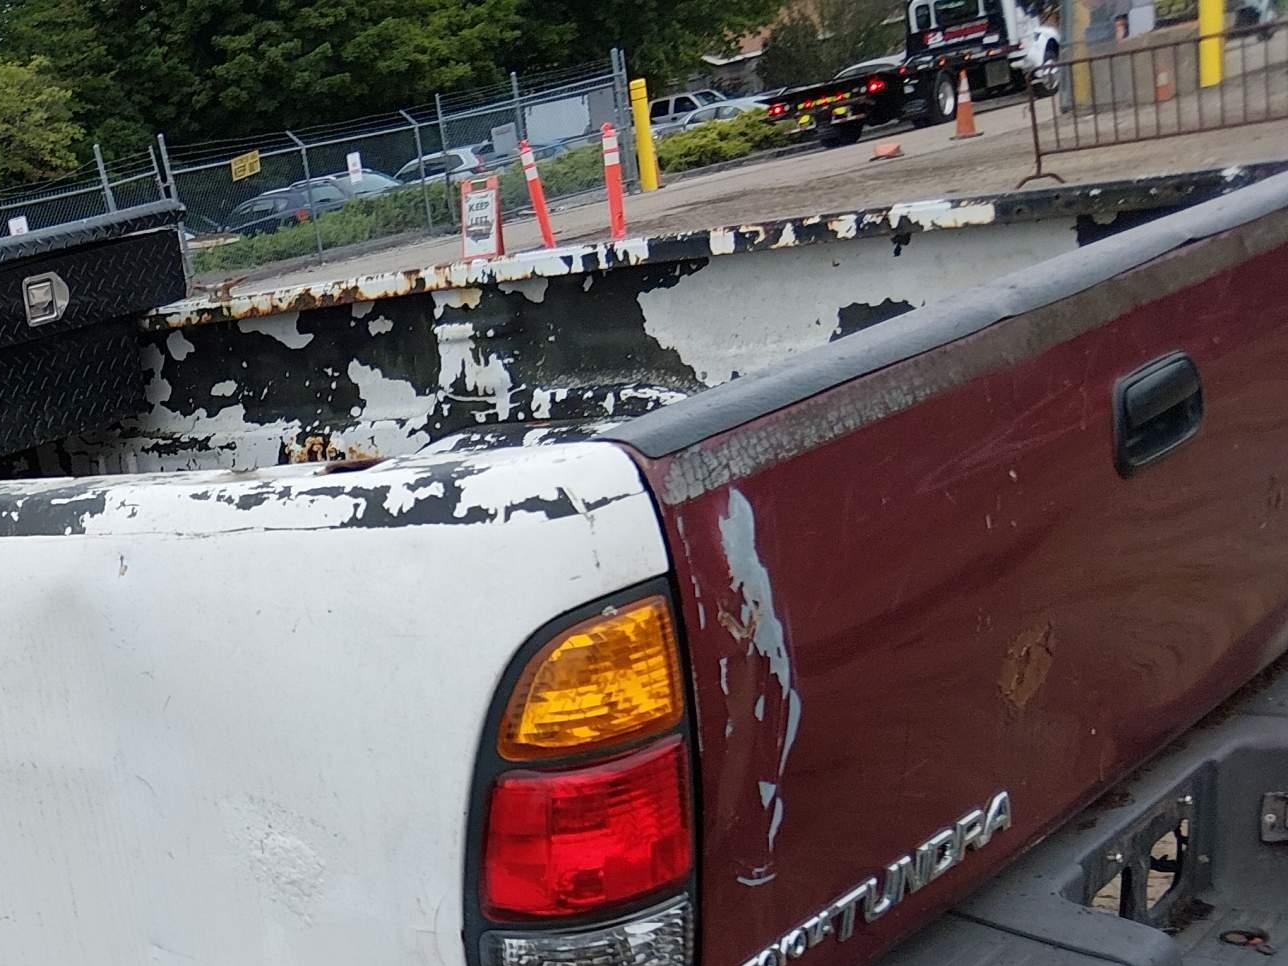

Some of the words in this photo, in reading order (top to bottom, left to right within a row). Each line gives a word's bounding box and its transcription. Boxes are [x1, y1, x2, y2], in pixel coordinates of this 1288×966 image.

[468, 201, 489, 212] KEEP
[470, 215, 489, 226] LEFT
[832, 791, 1012, 942] TUNDRA
